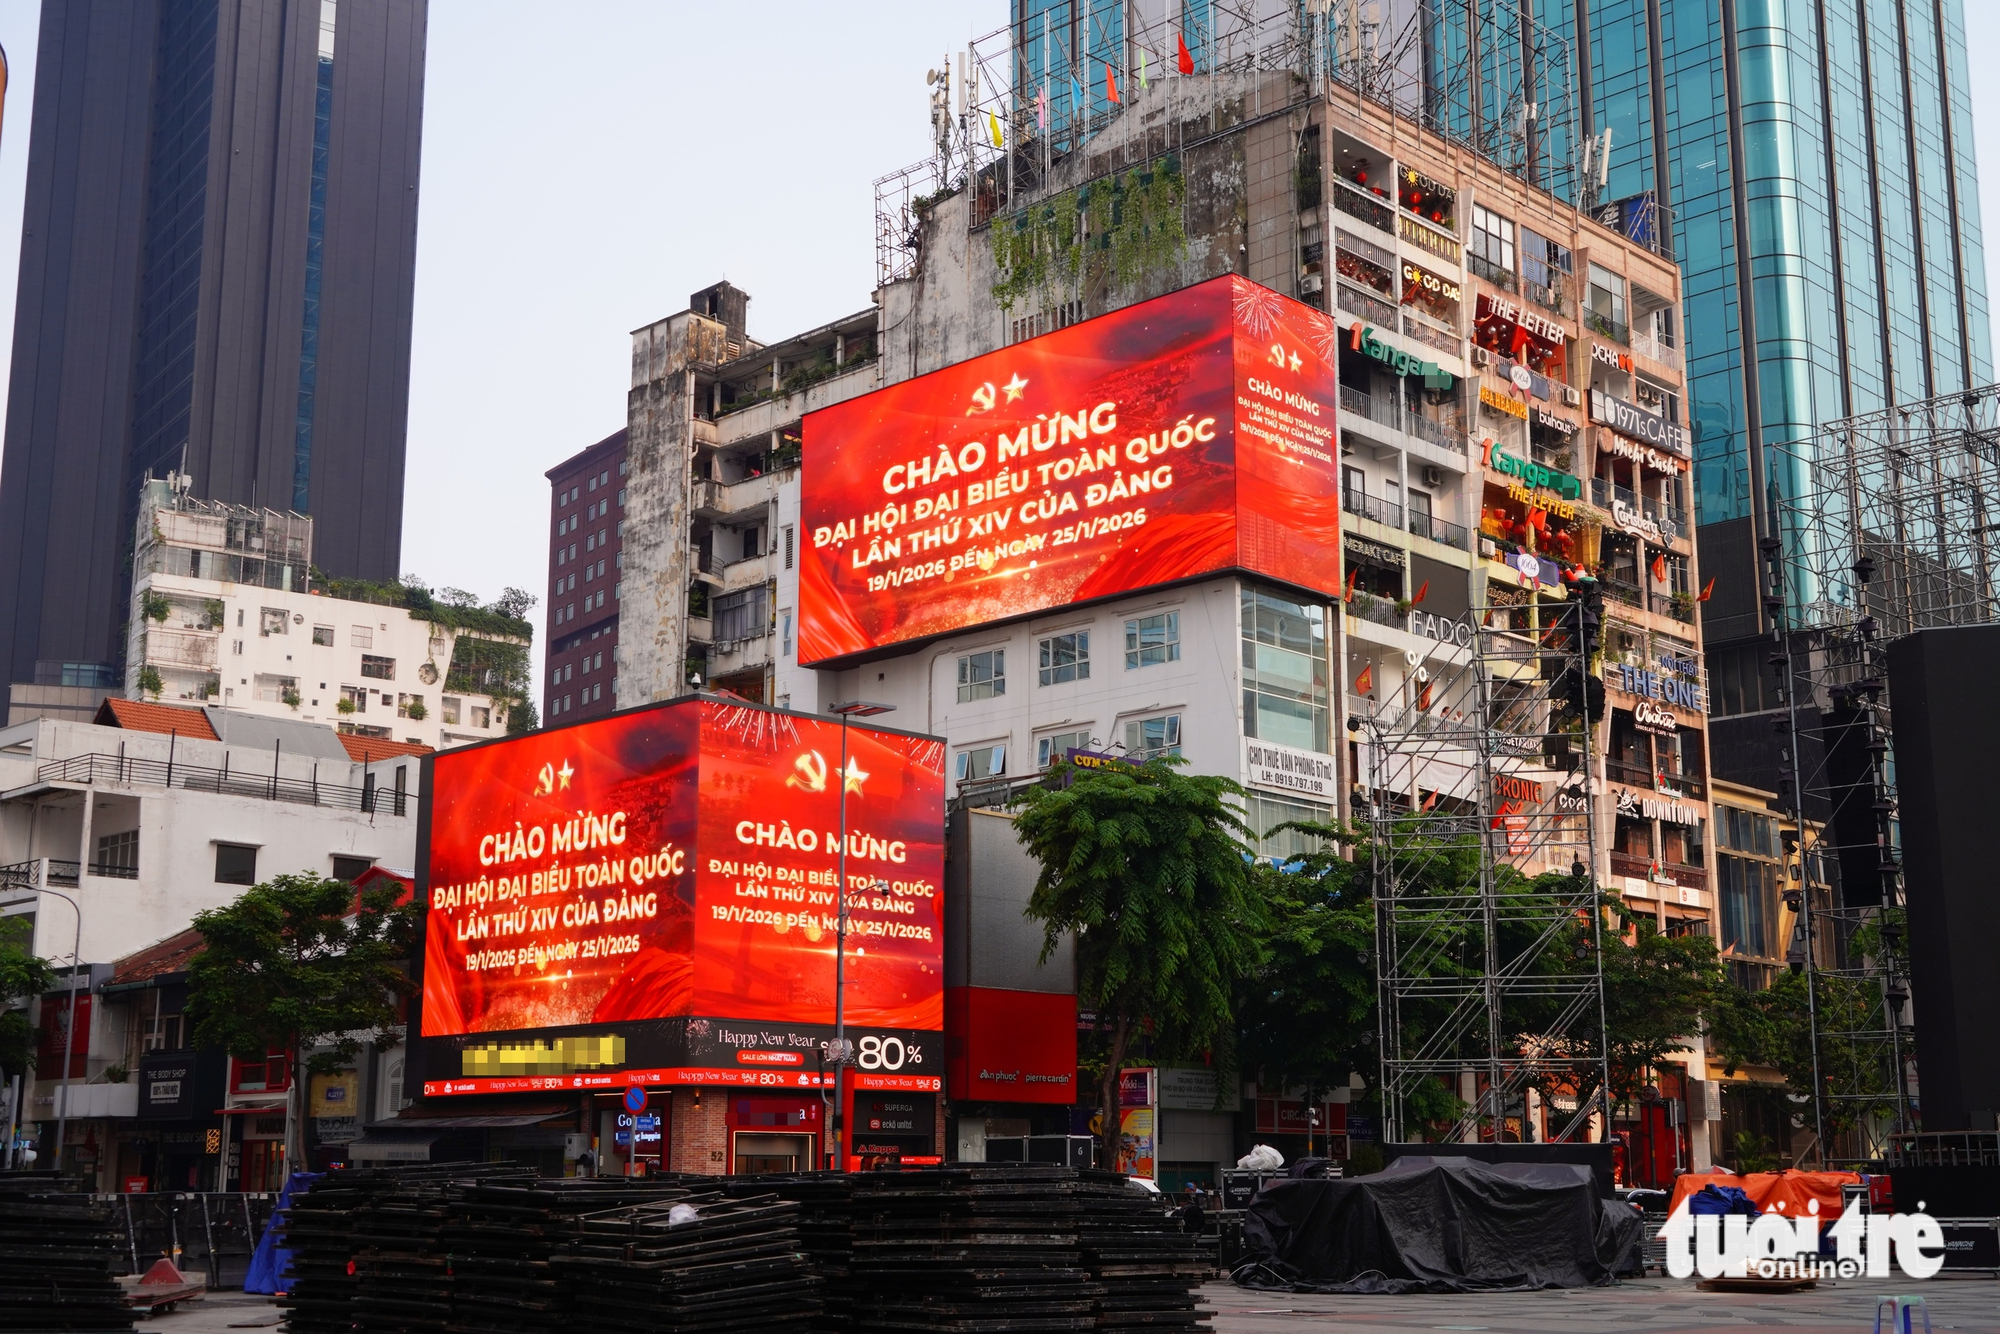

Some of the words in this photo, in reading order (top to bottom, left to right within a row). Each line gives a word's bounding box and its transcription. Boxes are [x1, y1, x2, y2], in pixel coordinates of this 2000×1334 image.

[1488, 293, 1516, 322] THE
[1517, 307, 1565, 346] LETTER
[1247, 377, 1283, 402] CHÀO
[1284, 391, 1320, 417] MỪNG
[1237, 396, 1251, 409] ĐẠI
[1251, 401, 1264, 413] HỘI
[1265, 406, 1277, 419] ĐẠI
[1294, 417, 1313, 432] TOÀN
[1313, 425, 1332, 439] QUỐC
[1240, 421, 1269, 439] 19/1/2026
[1263, 417, 1278, 429] THỨ
[1278, 422, 1290, 433] XIV
[1290, 427, 1305, 439] CỦA
[1305, 432, 1324, 447] ĐẢNG
[1646, 417, 1682, 452] CAFE
[882, 441, 987, 495] CHÀO
[997, 401, 1117, 464] MỪNG
[1613, 434, 1645, 464] Michi
[1647, 447, 1678, 477] Sushi
[813, 518, 856, 548] ĐẠI
[863, 502, 907, 535] HỘI
[913, 489, 959, 521] ĐẠI
[967, 466, 1030, 507] BIỂU
[1036, 444, 1117, 487] TOÀN
[1125, 413, 1216, 464] QUỐC
[852, 535, 901, 569] LẦN
[907, 516, 963, 554] THỨ
[967, 507, 1013, 539] XIV
[1019, 490, 1079, 524] CỦA
[1084, 464, 1173, 508] ĐẢNG
[1508, 482, 1531, 505] THE
[1532, 492, 1575, 521] LETTER
[1612, 499, 1658, 539] Carlsberg
[867, 559, 946, 592] 19/1/2026
[949, 545, 990, 572] ĐẾN
[993, 532, 1048, 561] NGÀY
[1052, 507, 1147, 547] 25/1/2026
[1521, 558, 1537, 572] 1664
[1412, 609, 1472, 649] FADO
[1619, 662, 1660, 699] THE
[1663, 676, 1703, 711] ONE
[1249, 745, 1263, 766] CHO
[1280, 750, 1294, 772] VĂN
[1294, 752, 1315, 777] PHÒNG
[1261, 770, 1273, 782] LH:
[1274, 772, 1323, 793] 0919.797.199
[479, 821, 546, 867] CHÀO
[551, 810, 627, 855] MỪNG
[735, 819, 819, 852] CHÀO
[826, 829, 906, 864] MỪNG
[433, 884, 461, 915] ĐẠI
[465, 874, 494, 911] HỘI
[497, 874, 527, 906] ĐẠI
[531, 860, 571, 896] BIỂU
[575, 855, 625, 890] TOÀN
[629, 842, 685, 886] QUỐC
[708, 859, 739, 879] ĐẠI
[743, 861, 772, 882] HỘI
[775, 867, 804, 886] ĐẠI
[892, 879, 934, 898] QUỐC
[735, 879, 768, 899] LẦN
[772, 886, 806, 902] THỨ
[808, 890, 834, 905] XIV
[871, 895, 915, 914] ĐẢNG
[457, 908, 489, 942] LẦN
[493, 904, 529, 937] THỨ
[530, 906, 560, 933] XIV
[562, 895, 600, 928] CỦA
[603, 888, 657, 923] ĐẢNG
[711, 905, 783, 925] 19/1/2026
[785, 910, 819, 929] ĐẾN
[866, 920, 931, 940] 25/1/2026
[465, 949, 516, 972] 19/1/2026
[518, 940, 544, 965] ĐẾN
[545, 938, 580, 961] NGÀY
[581, 934, 640, 958] 25/1/2026
[718, 1029, 758, 1048] Happy
[760, 1031, 785, 1046] New
[788, 1033, 816, 1047] Year
[147, 1070, 157, 1079] THE
[157, 1069, 171, 1079] BODY
[171, 1068, 187, 1078] SHOP
[678, 1071, 704, 1081] Happy
[705, 1071, 720, 1080] New
[721, 1072, 738, 1080] Year
[863, 1077, 884, 1087] Happy
[1025, 1073, 1046, 1083] pierre
[1047, 1073, 1069, 1083] cardin
[1177, 1077, 1193, 1085] TRUNG
[884, 1103, 913, 1112] SUPERGA
[163, 1132, 176, 1143] THE
[176, 1132, 194, 1143] BODY
[868, 1144, 899, 1155] Kappa
[1077, 1146, 1084, 1156] 6
[227, 1167, 239, 1179] LA
[710, 1151, 724, 1162] 52
